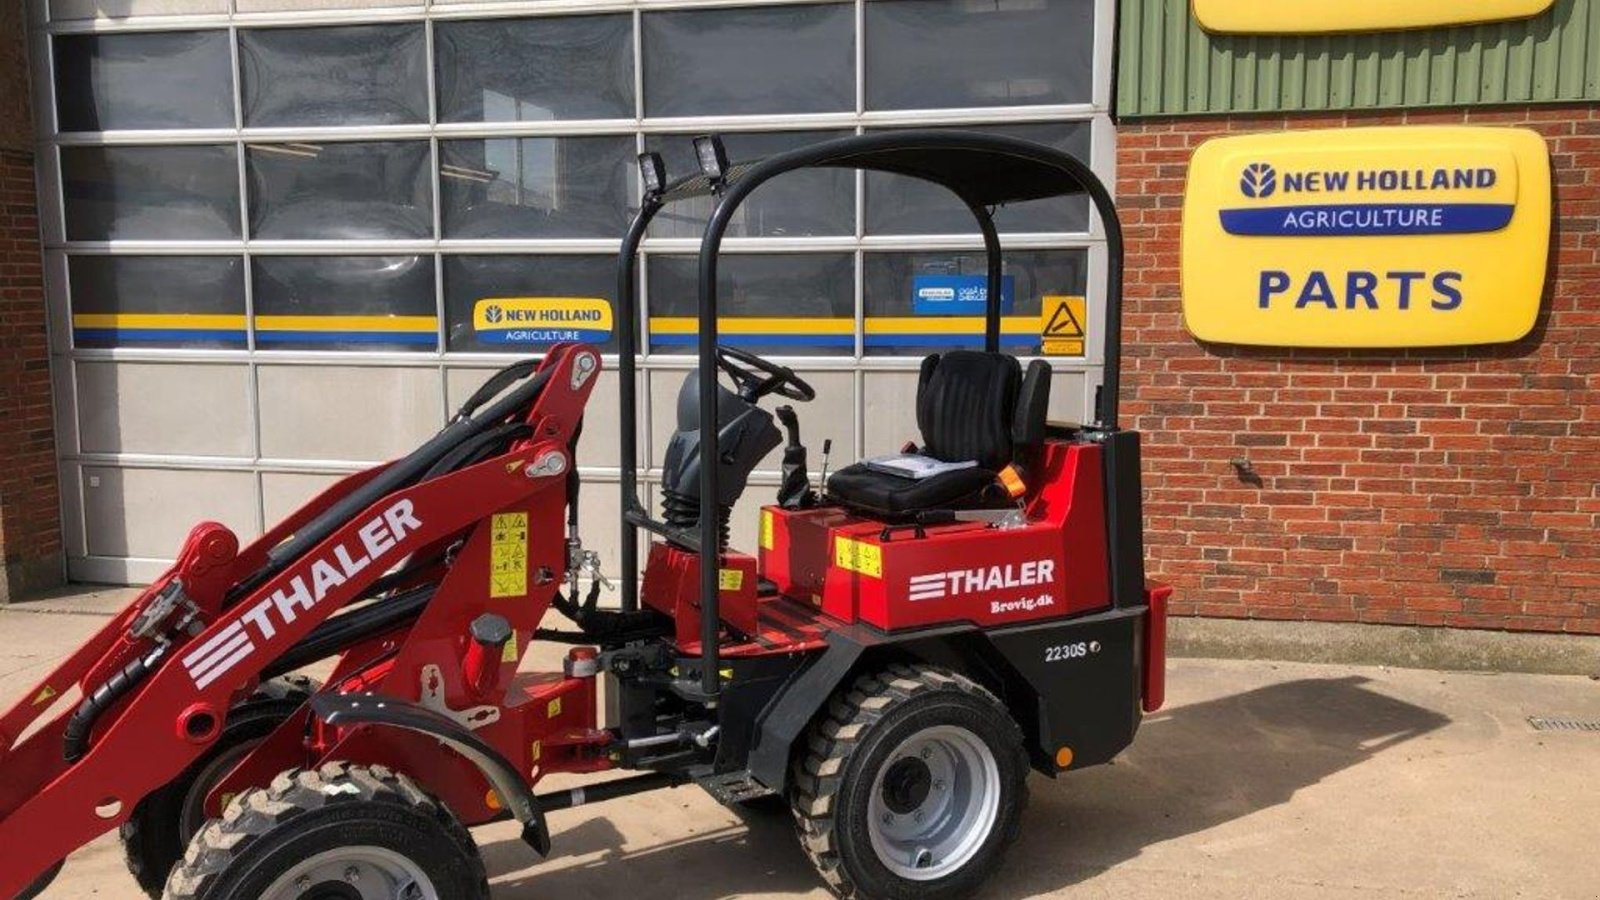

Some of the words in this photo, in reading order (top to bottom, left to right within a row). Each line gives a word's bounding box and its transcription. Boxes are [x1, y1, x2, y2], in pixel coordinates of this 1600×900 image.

[1284, 172, 1349, 193] NEW
[1357, 168, 1496, 191] HOLLAND
[1283, 208, 1443, 229] AGRICULTURE
[1257, 270, 1463, 311] PARTS
[506, 309, 536, 321] NEW
[540, 309, 602, 321] HOLLAND
[505, 331, 580, 341] AGRICULTURE
[240, 497, 423, 641] THALER
[947, 559, 1055, 595] THALER
[1045, 642, 1087, 662] 2230S
